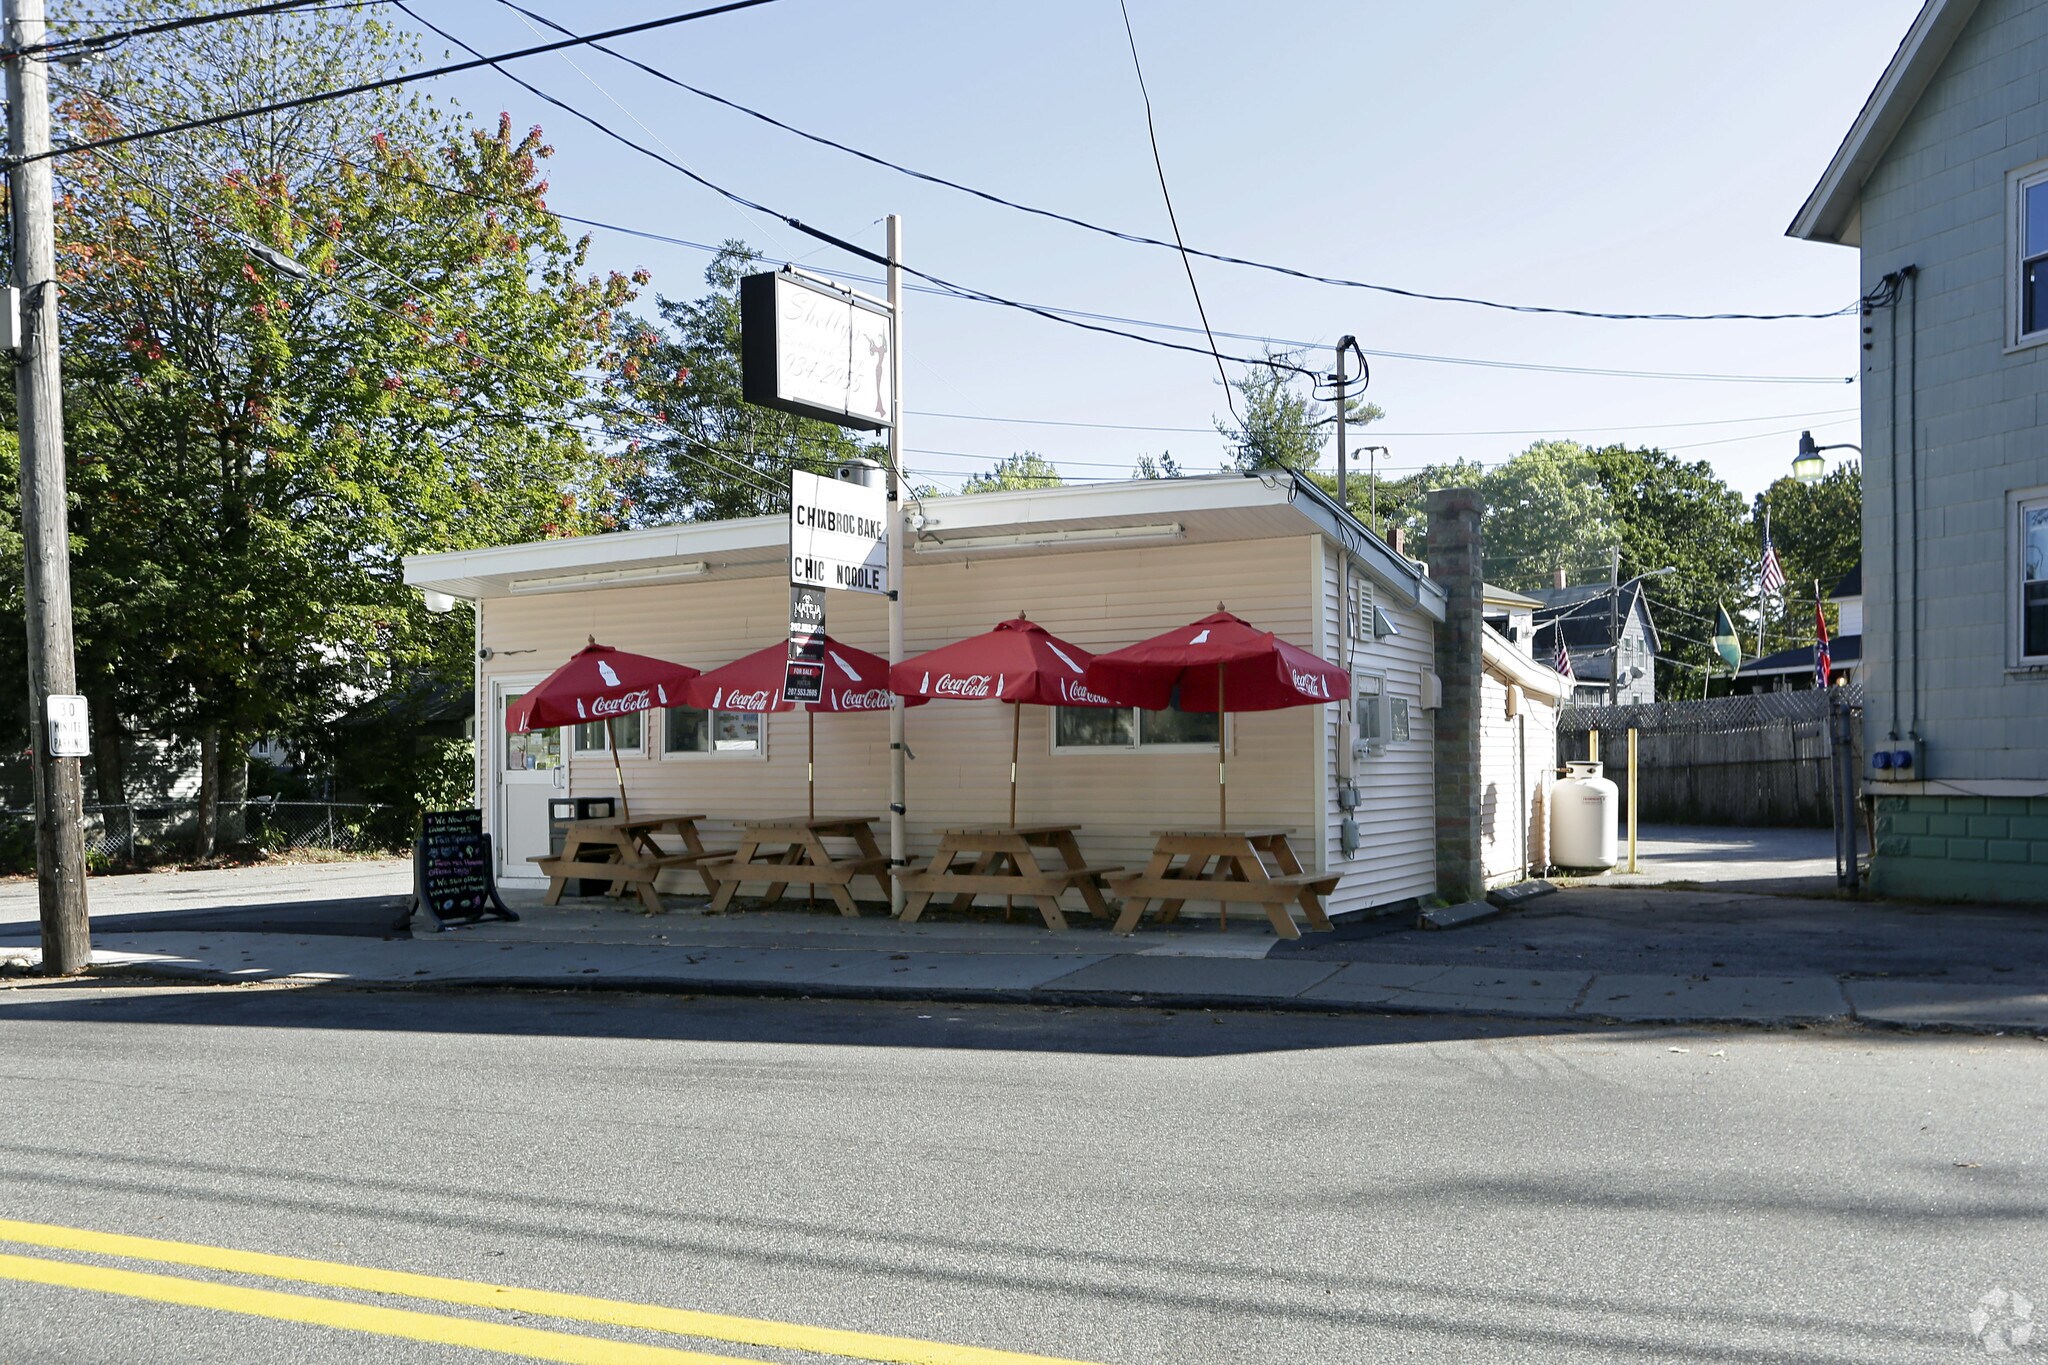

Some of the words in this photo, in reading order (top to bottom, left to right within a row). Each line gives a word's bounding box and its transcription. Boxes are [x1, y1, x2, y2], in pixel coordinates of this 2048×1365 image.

[857, 517, 882, 540] BAKE
[794, 556, 825, 581] CHIC
[836, 564, 879, 590] NOODLE
[793, 667, 802, 675] FOR
[935, 673, 992, 696] Coca-Cola
[591, 689, 650, 716] Coca-Cola
[726, 689, 770, 710] Coca-Cola
[842, 689, 889, 709] Coca-Cola
[61, 702, 75, 717] 30
[54, 721, 82, 733] MINUTE
[54, 737, 84, 749] PARKING
